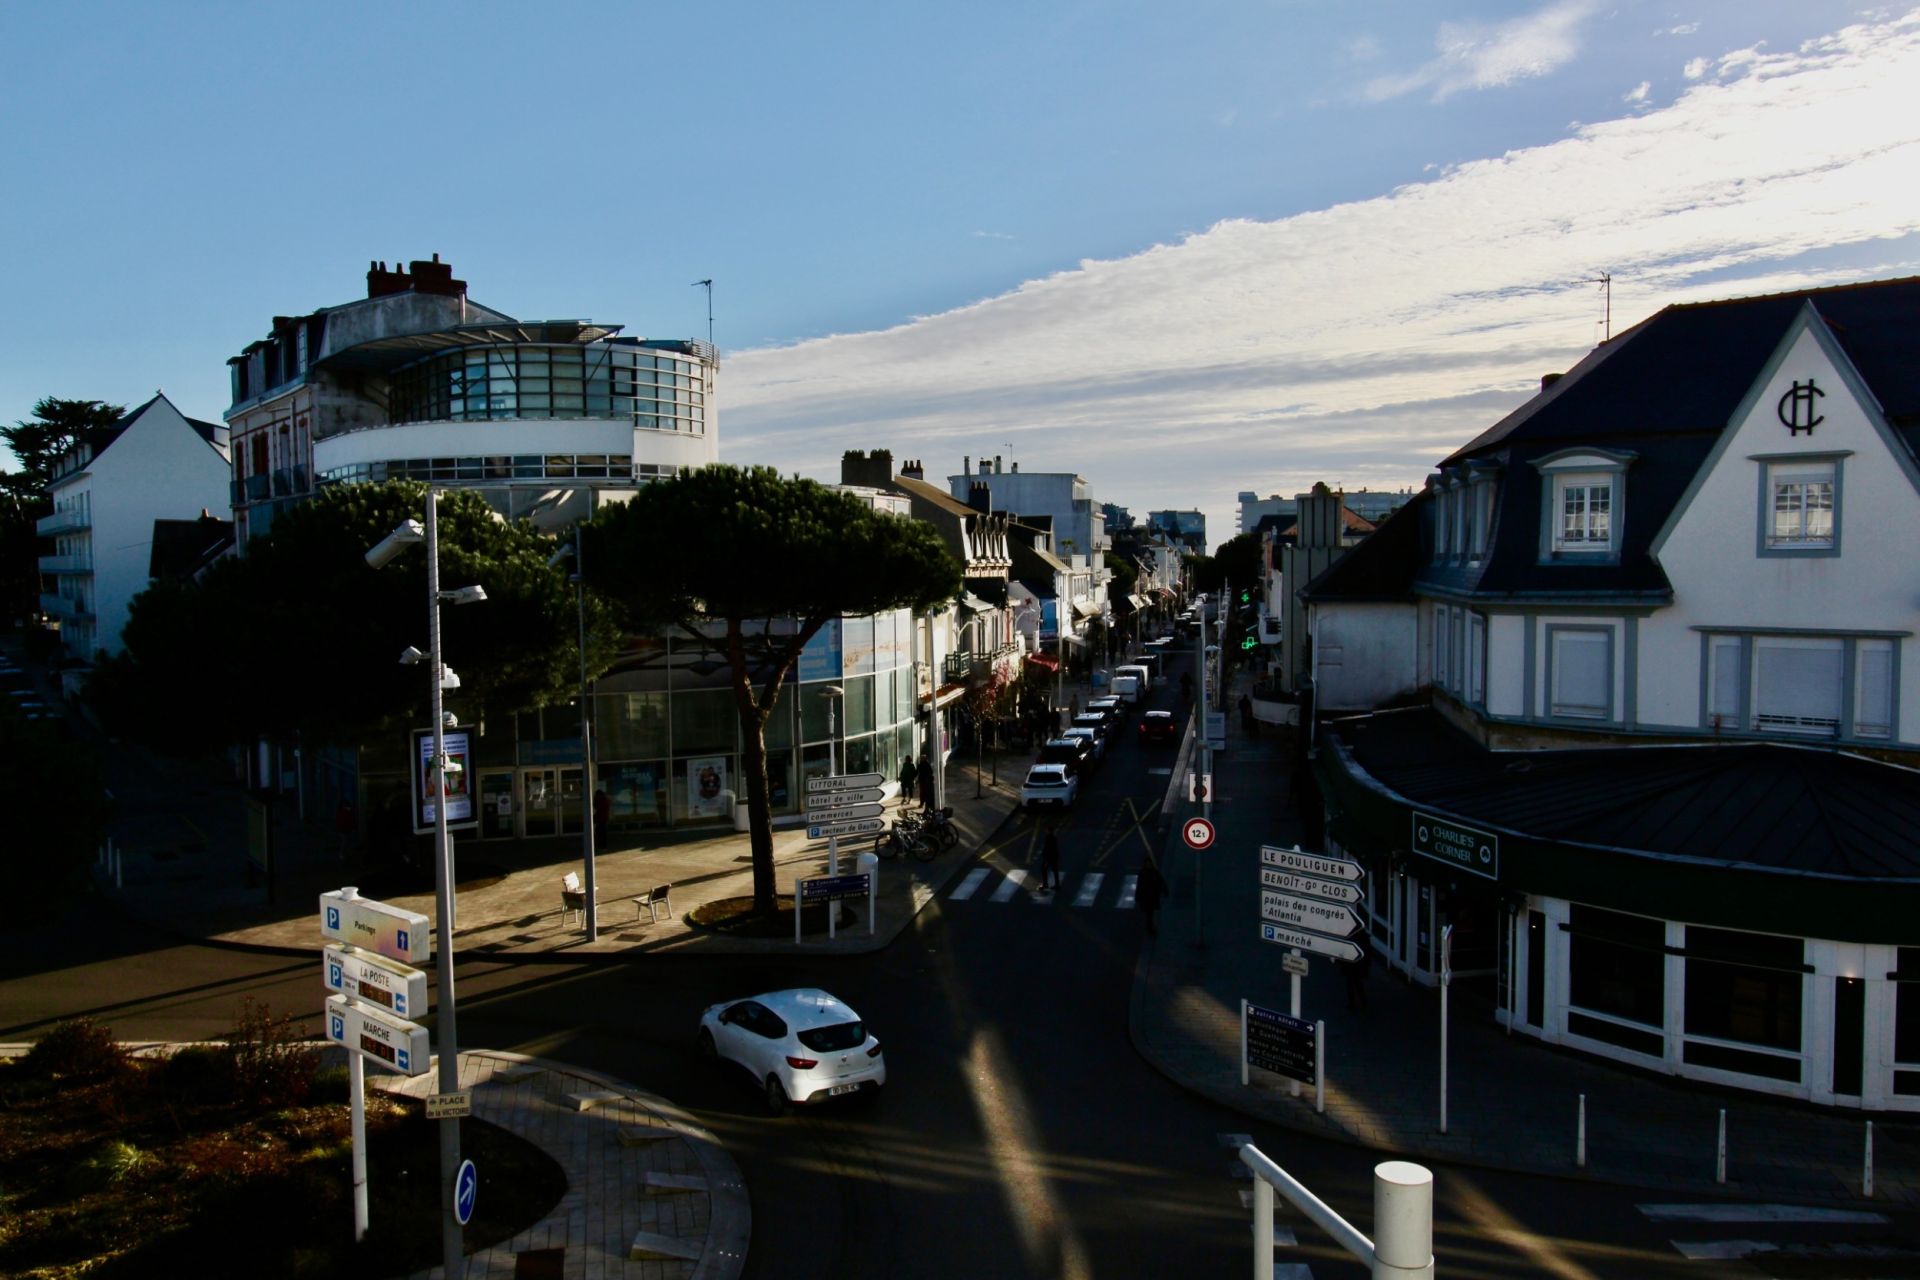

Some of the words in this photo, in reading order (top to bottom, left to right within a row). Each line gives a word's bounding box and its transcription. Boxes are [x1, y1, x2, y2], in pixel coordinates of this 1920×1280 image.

[810, 780, 847, 789] LITTORAL
[810, 797, 831, 805] hôtel
[847, 793, 864, 801] ville
[811, 811, 853, 820] commerces
[821, 826, 846, 834] secteur
[1434, 841, 1472, 863] CORNER
[1264, 852, 1275, 862] LE
[1281, 855, 1345, 875] POULIGUEN
[1321, 884, 1348, 898] CLOS
[1264, 896, 1289, 908] palais
[1292, 901, 1307, 912] des
[1277, 931, 1312, 947] marché
[327, 953, 344, 968] Parking
[360, 966, 368, 977] LA
[369, 970, 390, 987] POSTE
[363, 1021, 390, 1041] MARCHE
[439, 1096, 465, 1105] PLACE
